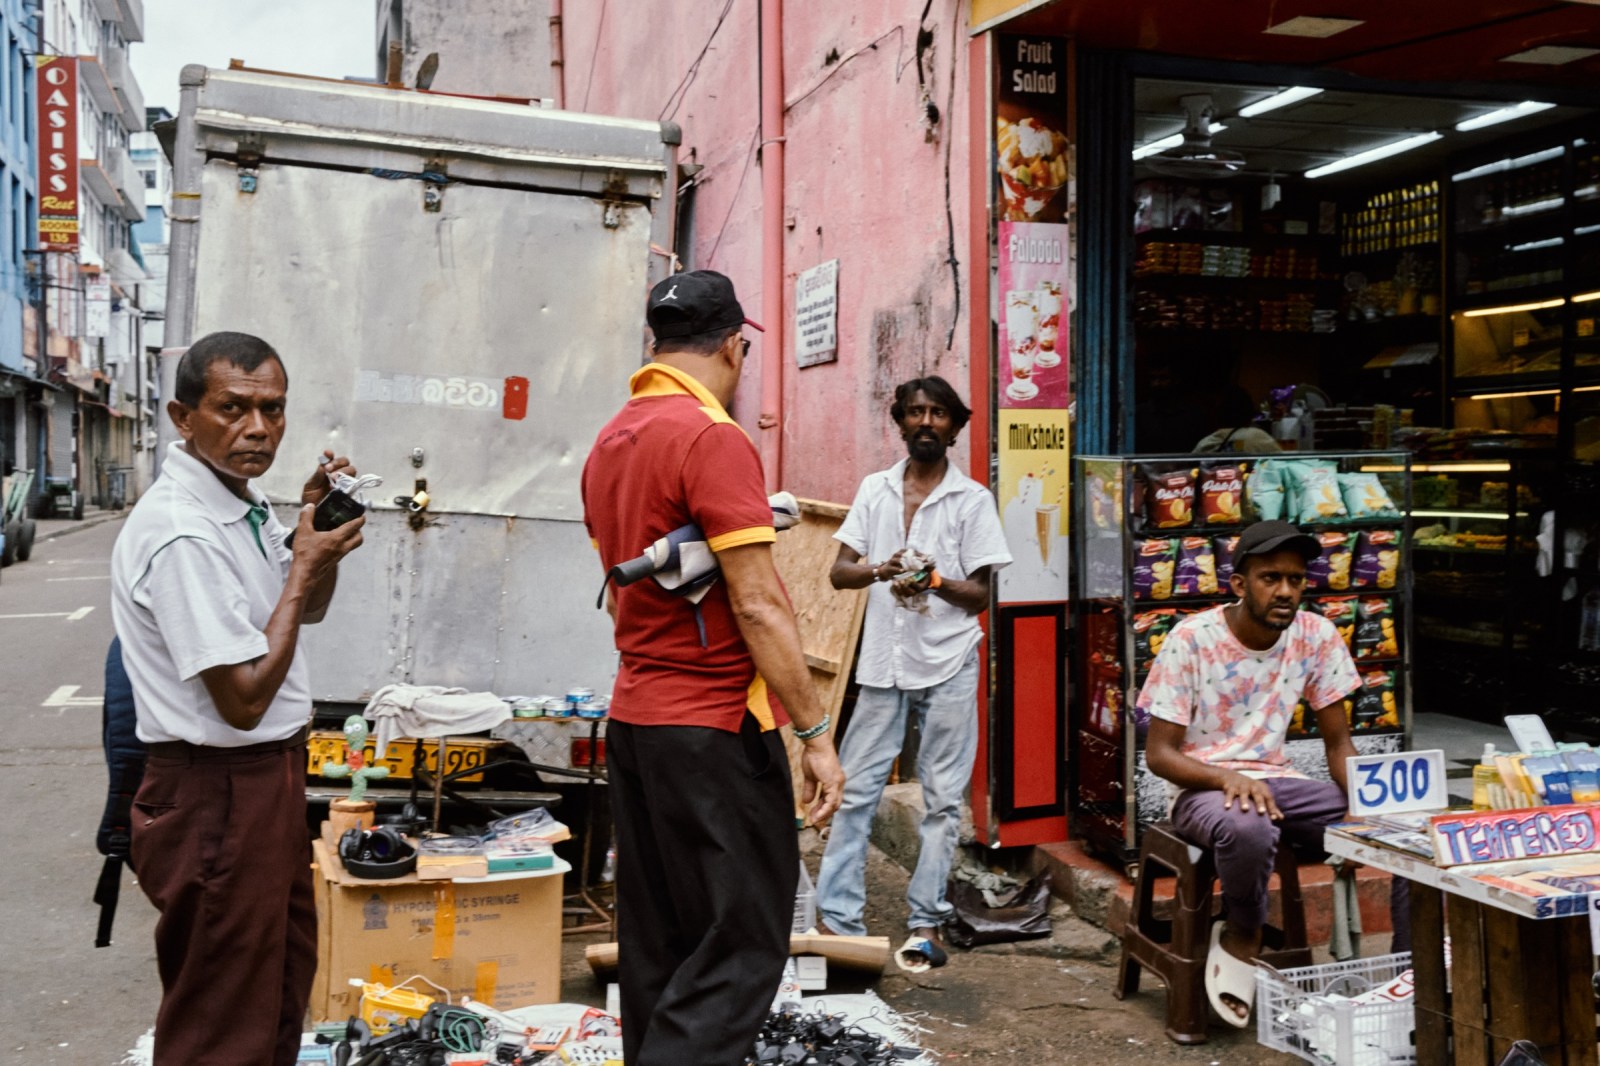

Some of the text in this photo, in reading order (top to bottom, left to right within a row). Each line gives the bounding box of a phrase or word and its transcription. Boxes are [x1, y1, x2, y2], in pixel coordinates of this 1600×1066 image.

[1017, 39, 1053, 64] Fruit
[1013, 69, 1056, 94] Salad
[45, 67, 69, 193] OASISS
[1009, 234, 1062, 264] Falooda
[1009, 423, 1065, 450] Milkshake
[1357, 757, 1429, 808] 300
[1438, 811, 1595, 864] TEMPERED
[471, 893, 520, 909] SYRINGE
